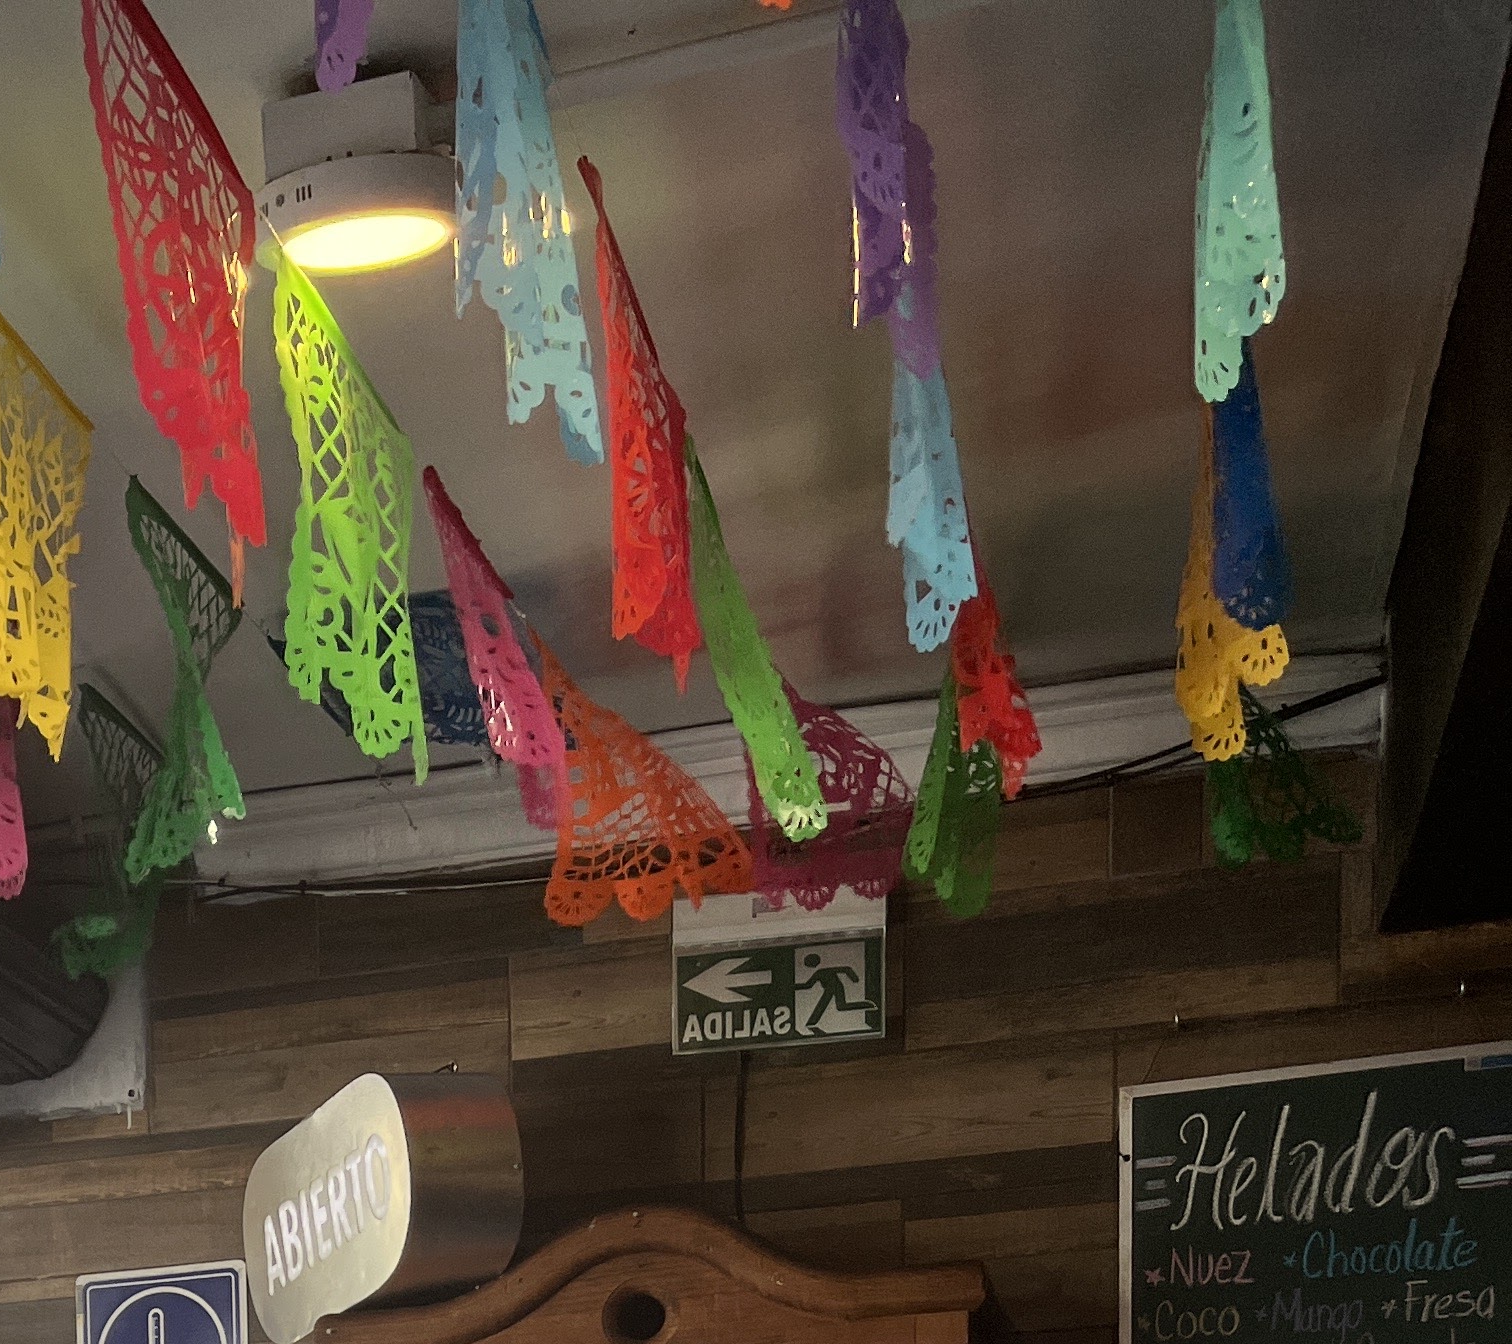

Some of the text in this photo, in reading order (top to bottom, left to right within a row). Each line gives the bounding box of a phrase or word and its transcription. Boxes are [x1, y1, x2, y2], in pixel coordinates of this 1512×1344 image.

[1170, 1088, 1455, 1231] Helados
[263, 1133, 391, 1297] ABIERTO
[1170, 1215, 1479, 1287] Nuez Chocolate
[1155, 1300, 1240, 1341] Coco
[1403, 1279, 1495, 1323] Fresa
